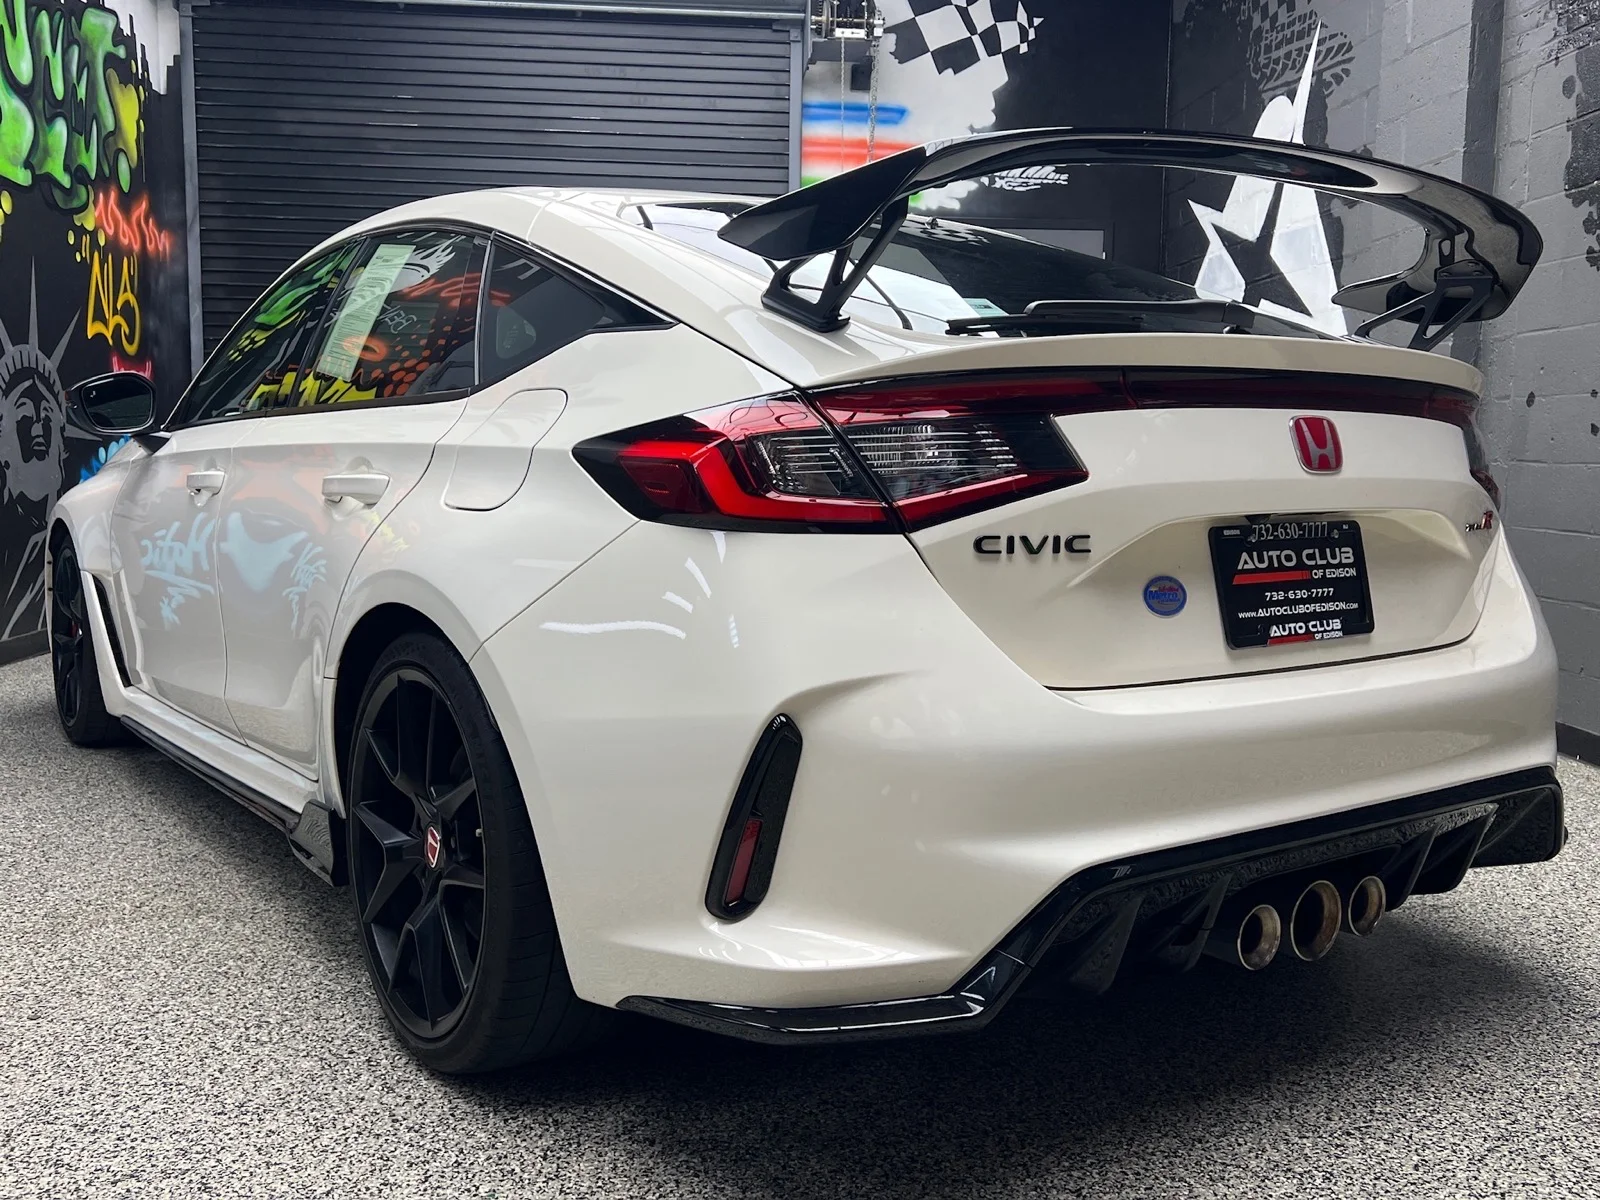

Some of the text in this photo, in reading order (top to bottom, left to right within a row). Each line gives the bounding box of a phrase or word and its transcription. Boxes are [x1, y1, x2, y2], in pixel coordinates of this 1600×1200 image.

[1252, 522, 1328, 541] 732-630-7777
[973, 534, 1092, 555] CIVIC
[1237, 547, 1354, 570] AUTO CLUB
[1312, 567, 1357, 579] OF EDISON
[1269, 619, 1342, 637] AUTO CLUB
[1314, 630, 1343, 640] OF EDISON
